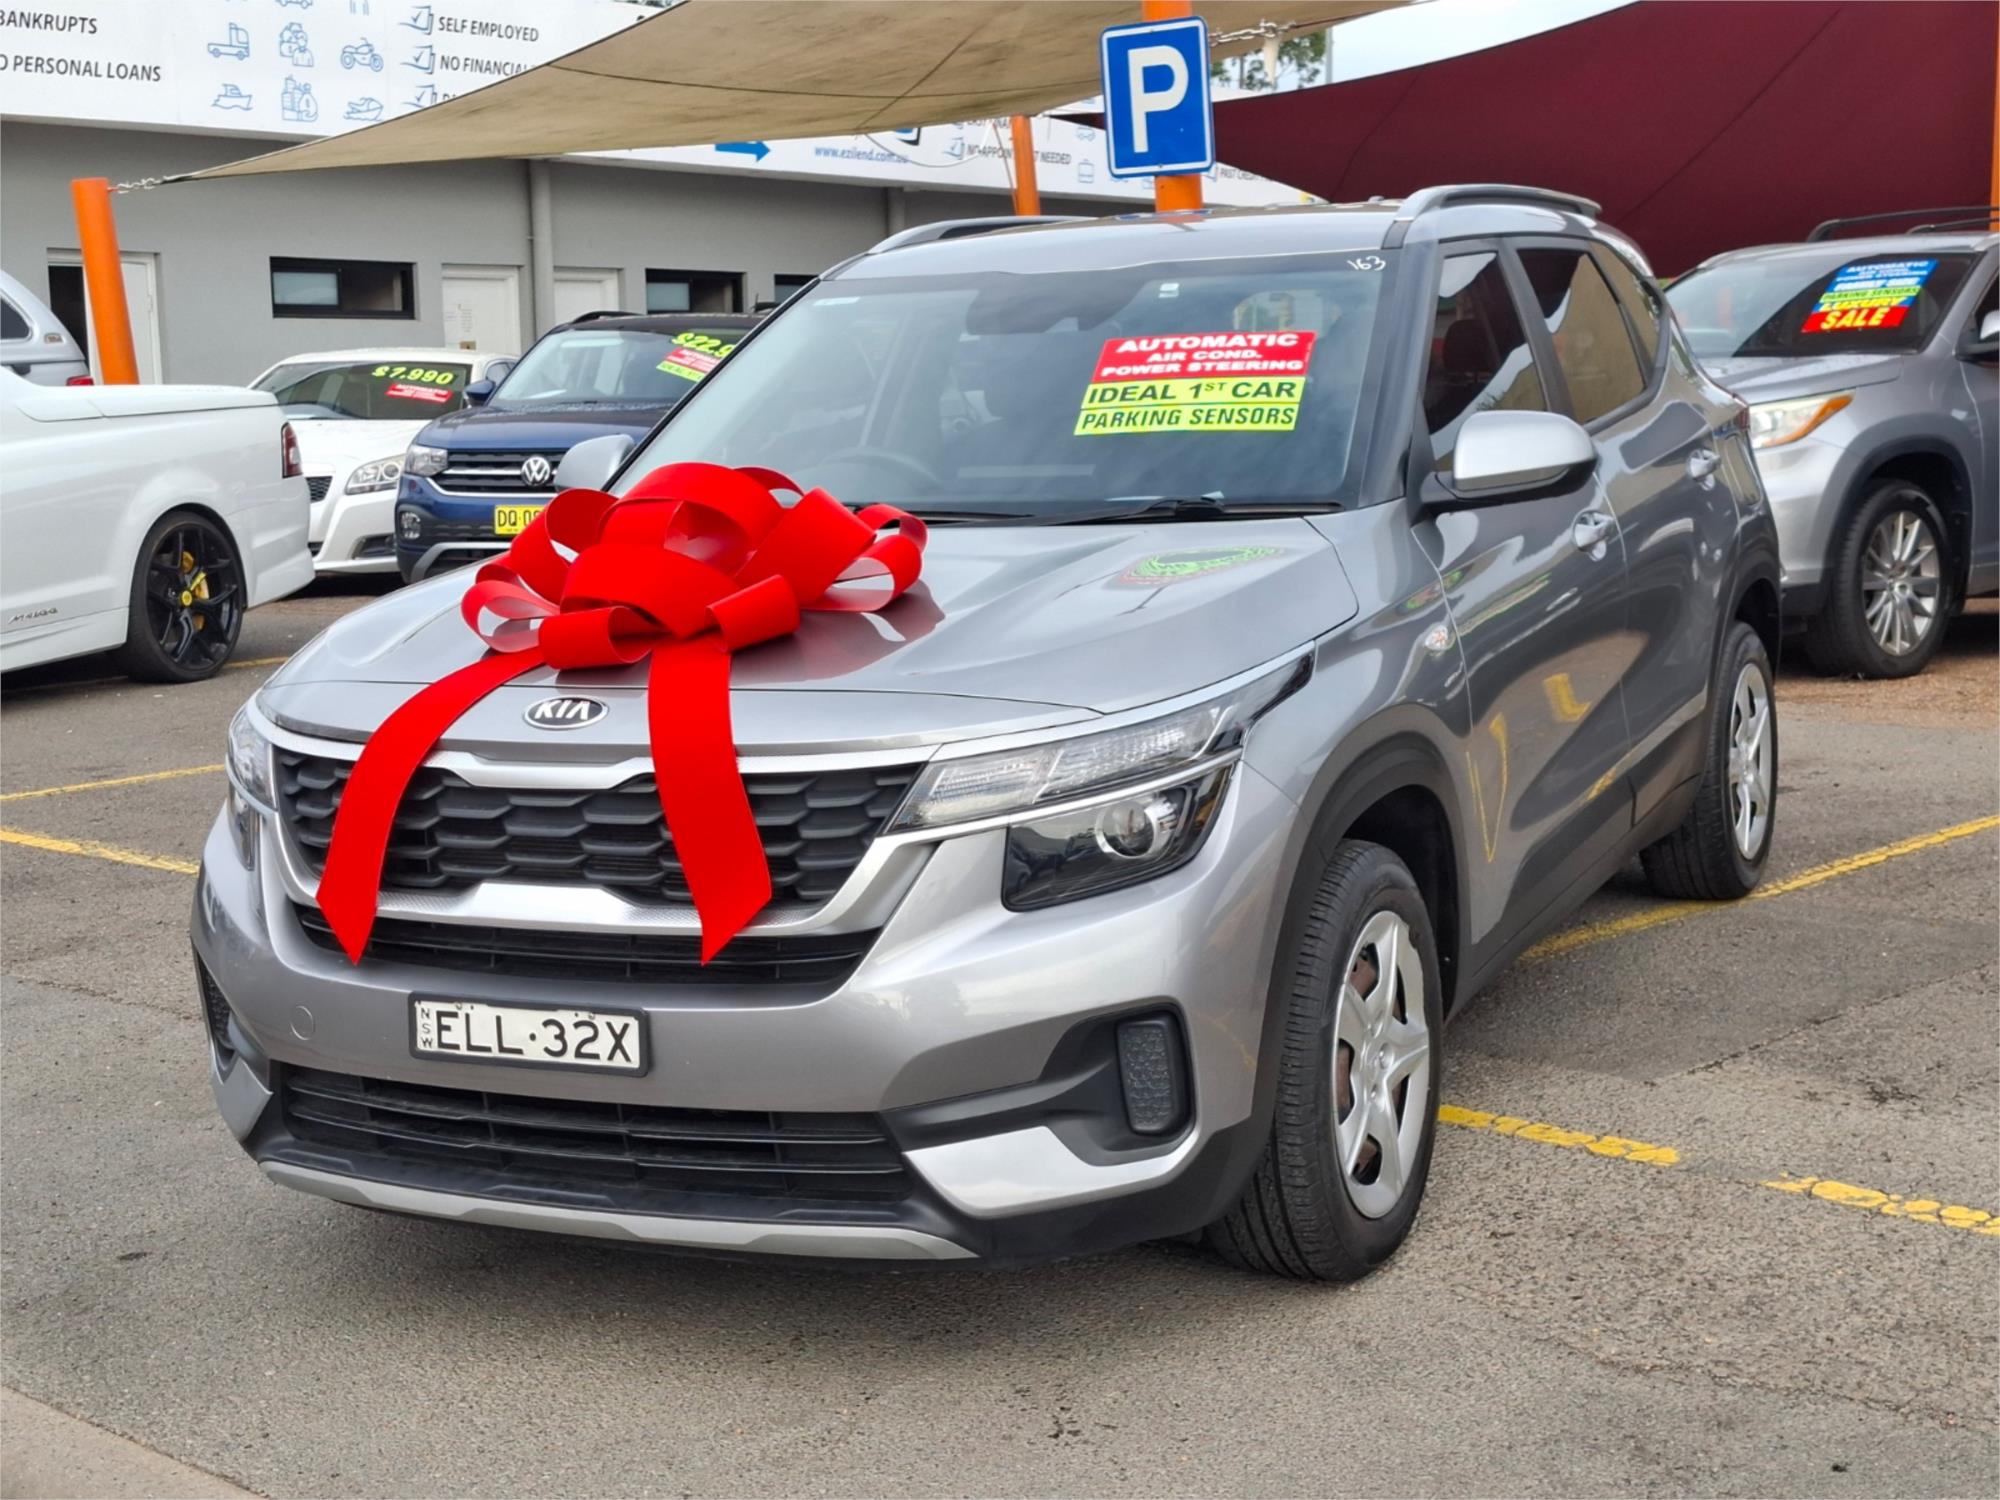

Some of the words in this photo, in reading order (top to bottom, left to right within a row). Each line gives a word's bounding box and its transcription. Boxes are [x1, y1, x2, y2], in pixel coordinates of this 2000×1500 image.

[0, 10, 98, 34] BANKRUPTS
[438, 16, 468, 34] SELF
[470, 20, 539, 42] EMPLOYED
[13, 55, 102, 78] PERSONAL
[106, 62, 161, 82] LOANS
[440, 55, 460, 71] NO
[1128, 45, 1189, 153] P
[1040, 151, 1071, 164] NEEDED
[1347, 255, 1386, 271] 163
[1820, 306, 1891, 330] SALE
[1116, 333, 1299, 353] AUTOMATIC
[1146, 352, 1187, 363] AIR
[1192, 349, 1263, 360] COND.
[1101, 363, 1182, 377] POWER
[1187, 360, 1304, 374] STEERING
[1088, 384, 1176, 404] IDEAL
[1189, 382, 1227, 399] 1ST
[1231, 382, 1297, 398] CAR
[1082, 409, 1182, 429] PARKING
[1189, 407, 1295, 425] SENSORS
[534, 699, 591, 721] KIA
[420, 1008, 433, 1049] NSW
